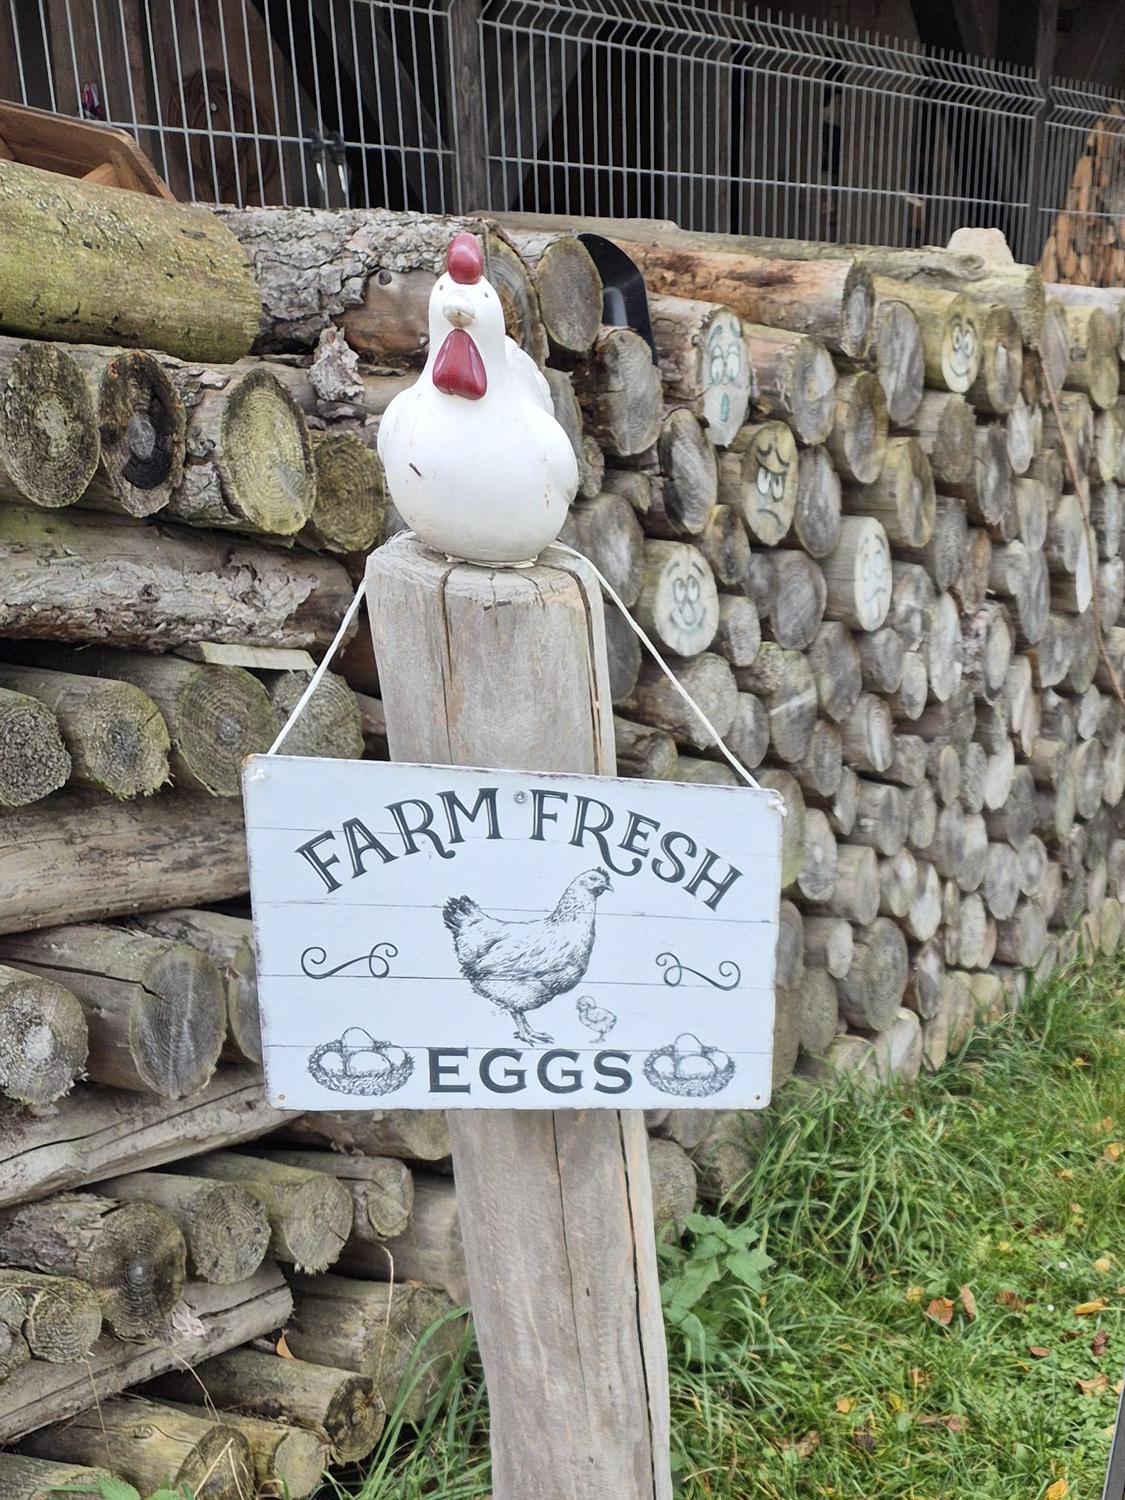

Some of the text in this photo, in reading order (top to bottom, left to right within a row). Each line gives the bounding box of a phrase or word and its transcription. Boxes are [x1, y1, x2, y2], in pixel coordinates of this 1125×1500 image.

[296, 787, 744, 912] FARM FRESH
[427, 1047, 633, 1094] EGGS
